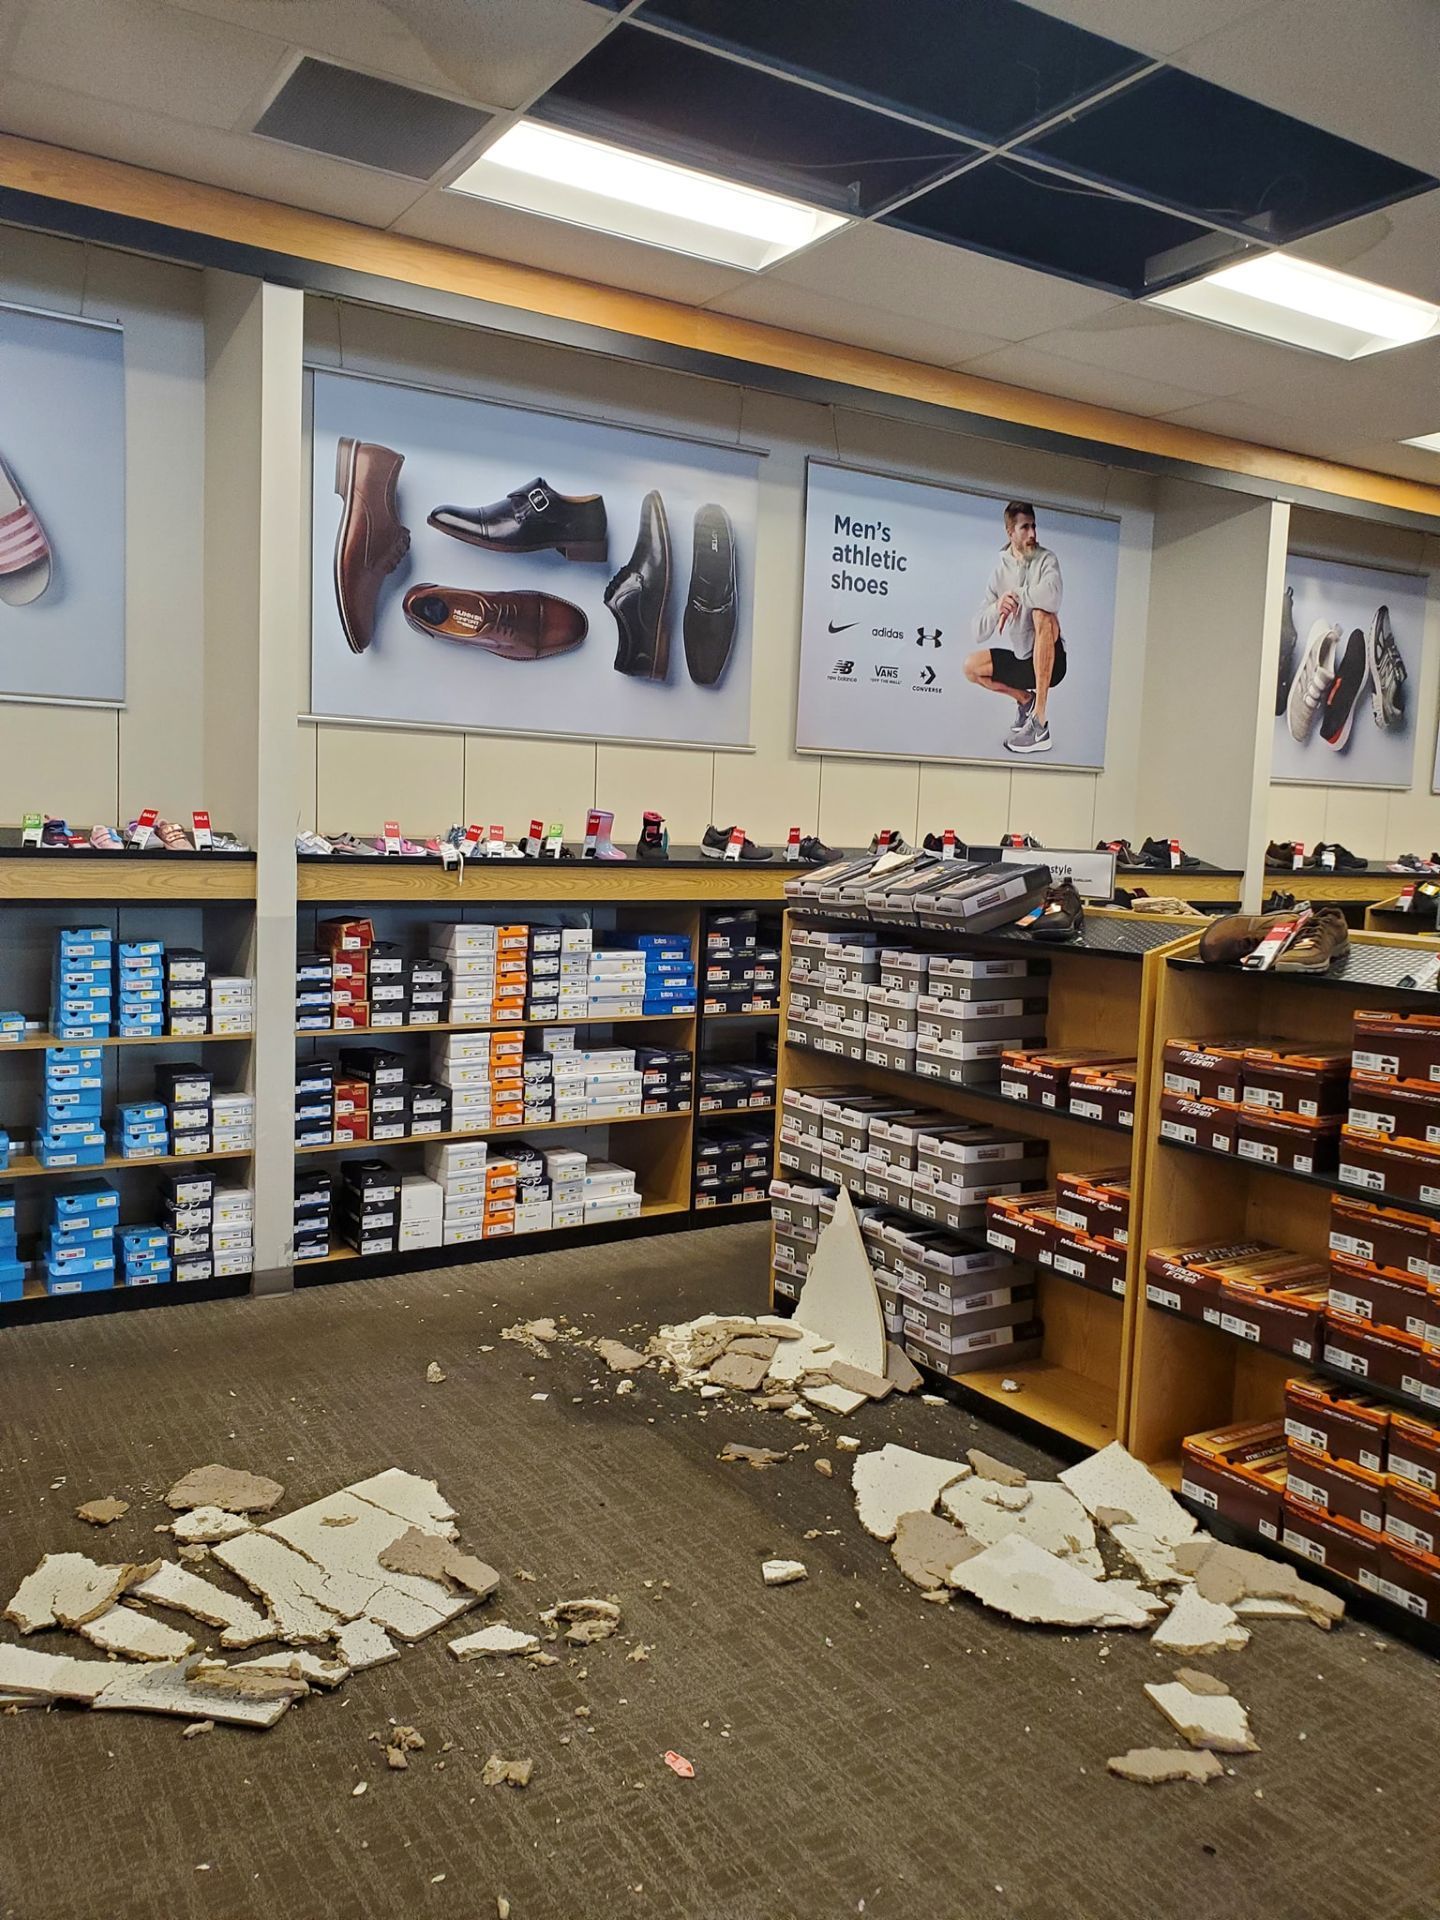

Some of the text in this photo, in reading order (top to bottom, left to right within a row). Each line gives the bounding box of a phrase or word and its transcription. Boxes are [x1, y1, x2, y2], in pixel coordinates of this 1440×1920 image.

[834, 514, 891, 543] Men's
[832, 544, 907, 572] athletic
[831, 570, 889, 596] shoes
[871, 627, 904, 640] adidas
[874, 664, 899, 679] VANS
[912, 685, 943, 694] CONVERSE
[1179, 1050, 1222, 1062] MEMORY
[1184, 1057, 1215, 1068] FOAM
[1001, 1063, 1053, 1080] MEMORY FOAM
[1070, 1081, 1132, 1096] MEMORY FOAM
[1177, 1099, 1220, 1112] MEMORY
[1181, 1106, 1213, 1117] FOAM
[1062, 1189, 1122, 1212] MEMORY FOAM
[992, 1212, 1046, 1236] MEMORY FOAM
[1060, 1237, 1120, 1262] MEMORY FOAM
[1162, 1263, 1205, 1280] MEMORY
[1166, 1271, 1197, 1284] FOAM
